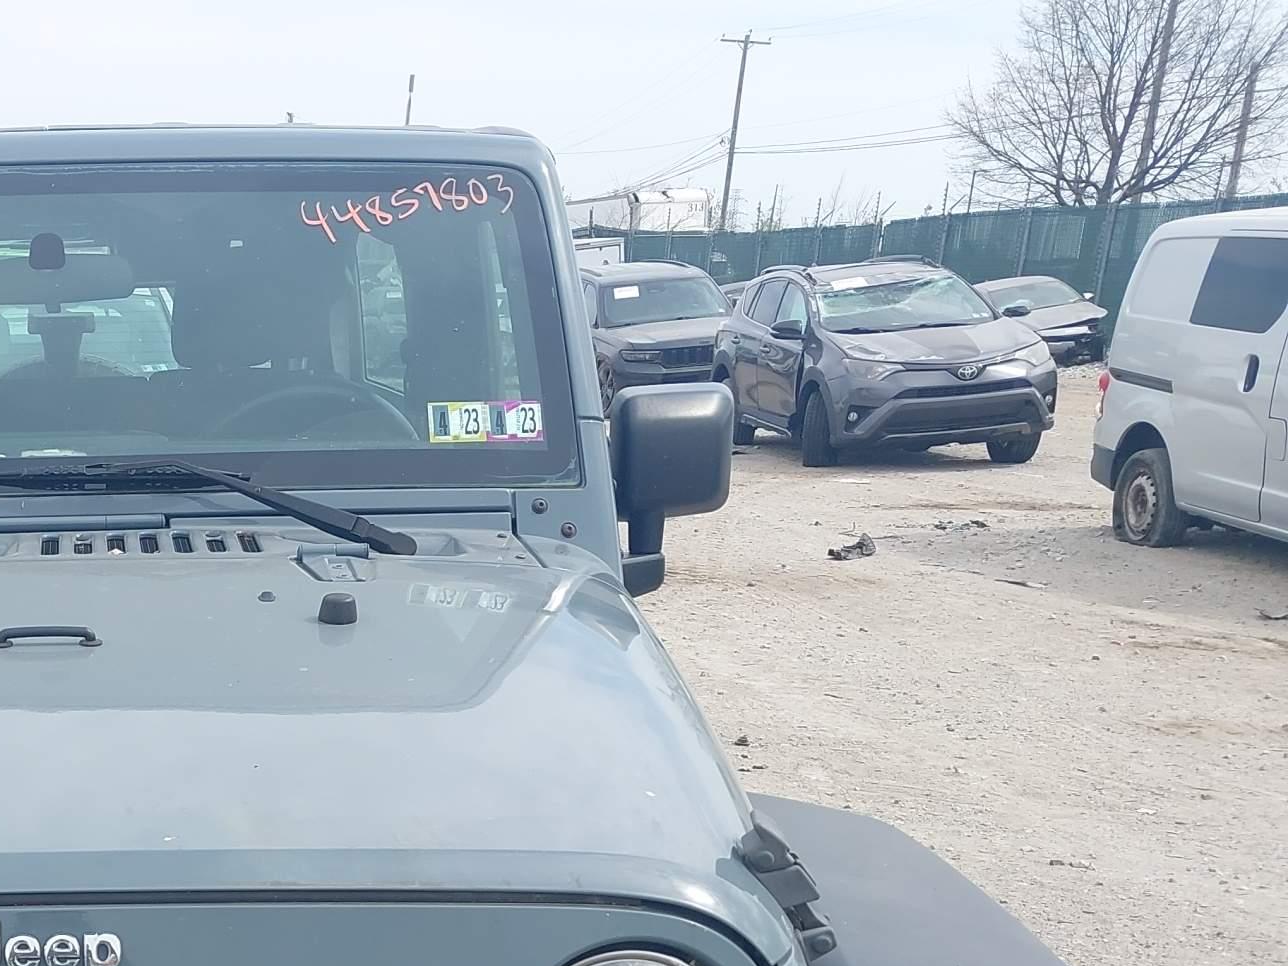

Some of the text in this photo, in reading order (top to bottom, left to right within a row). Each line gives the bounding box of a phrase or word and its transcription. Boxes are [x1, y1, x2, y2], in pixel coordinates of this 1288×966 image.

[300, 174, 514, 244] 44857803
[464, 408, 480, 434] 23
[520, 407, 537, 433] 23
